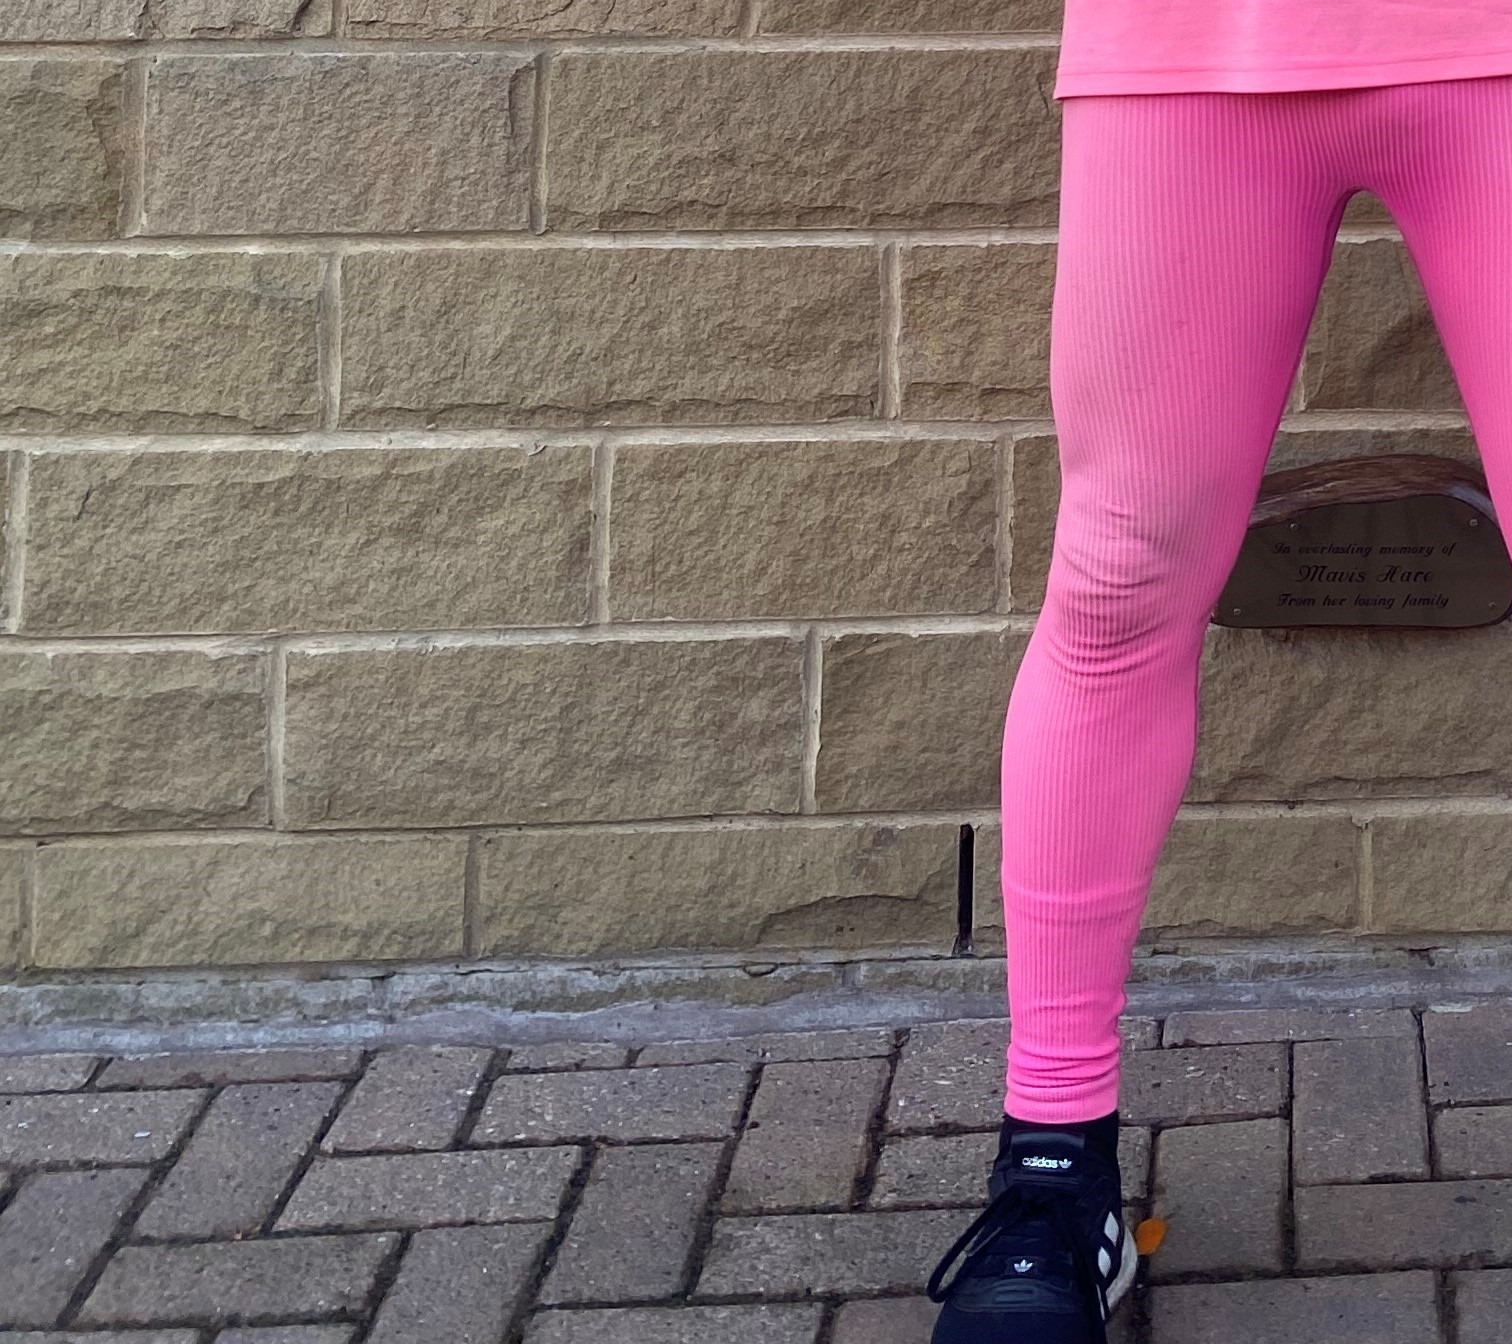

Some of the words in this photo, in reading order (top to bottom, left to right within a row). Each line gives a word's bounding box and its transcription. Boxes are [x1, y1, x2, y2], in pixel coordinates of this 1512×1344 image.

[1272, 542, 1291, 555] In
[1298, 542, 1372, 557] everlasting
[1379, 543, 1434, 557] memory
[1441, 541, 1457, 556] of
[1295, 564, 1366, 584] Mavis
[1376, 565, 1434, 584] Hare
[1277, 593, 1317, 608] From
[1322, 594, 1347, 607] her
[1354, 593, 1394, 609] loving
[1399, 593, 1449, 609] family
[1022, 1156, 1058, 1169] adidas
